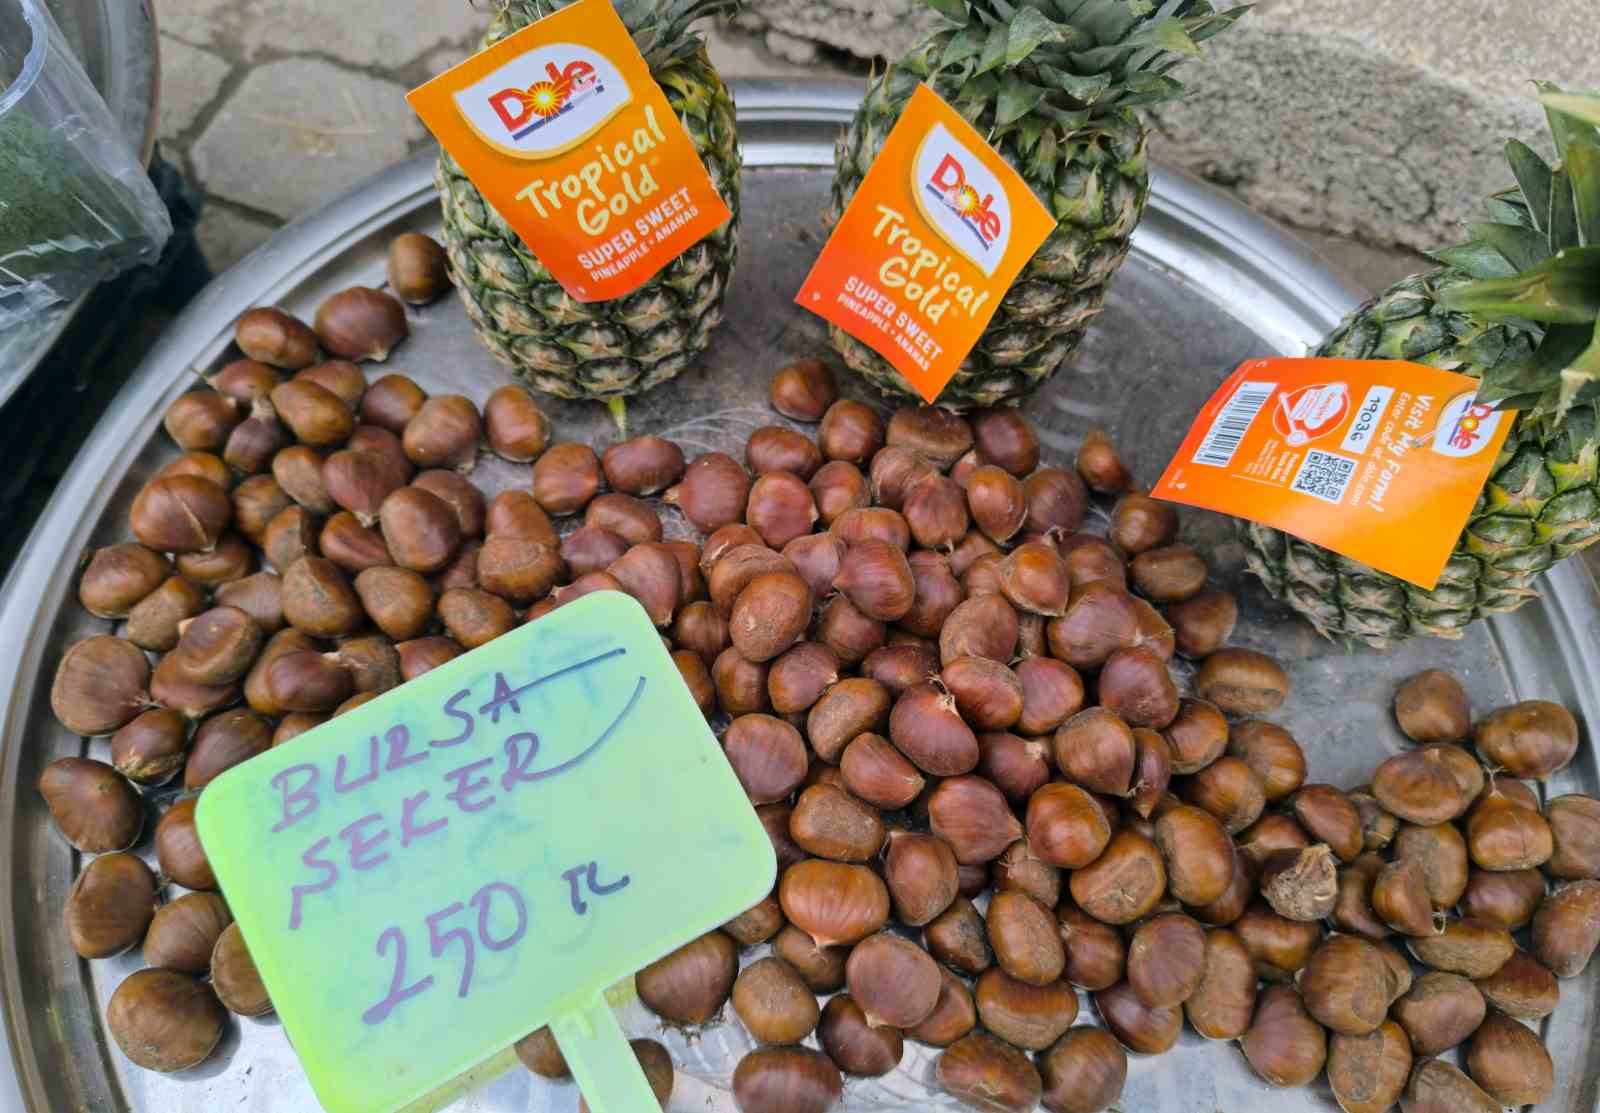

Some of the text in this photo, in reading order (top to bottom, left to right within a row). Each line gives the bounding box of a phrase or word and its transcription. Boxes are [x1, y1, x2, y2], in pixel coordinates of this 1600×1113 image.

[488, 60, 597, 132] Dole
[515, 104, 665, 218] Tropical
[577, 163, 659, 235] Gold
[931, 153, 1001, 241] Dole
[577, 186, 691, 269] SUPER SWEET
[591, 205, 699, 281] PINEAPPLE ANANAS
[872, 204, 989, 317] Tropical
[837, 292, 932, 372] PINEAPPLE ANANAS
[844, 275, 943, 360] SUPER SWEET
[879, 257, 951, 325] Gold
[1350, 396, 1381, 441] 19036
[1366, 394, 1435, 512] Visit My Farm!
[1455, 402, 1494, 449] Dole
[271, 648, 627, 833] BURSA
[361, 862, 631, 1026] 250 TL
